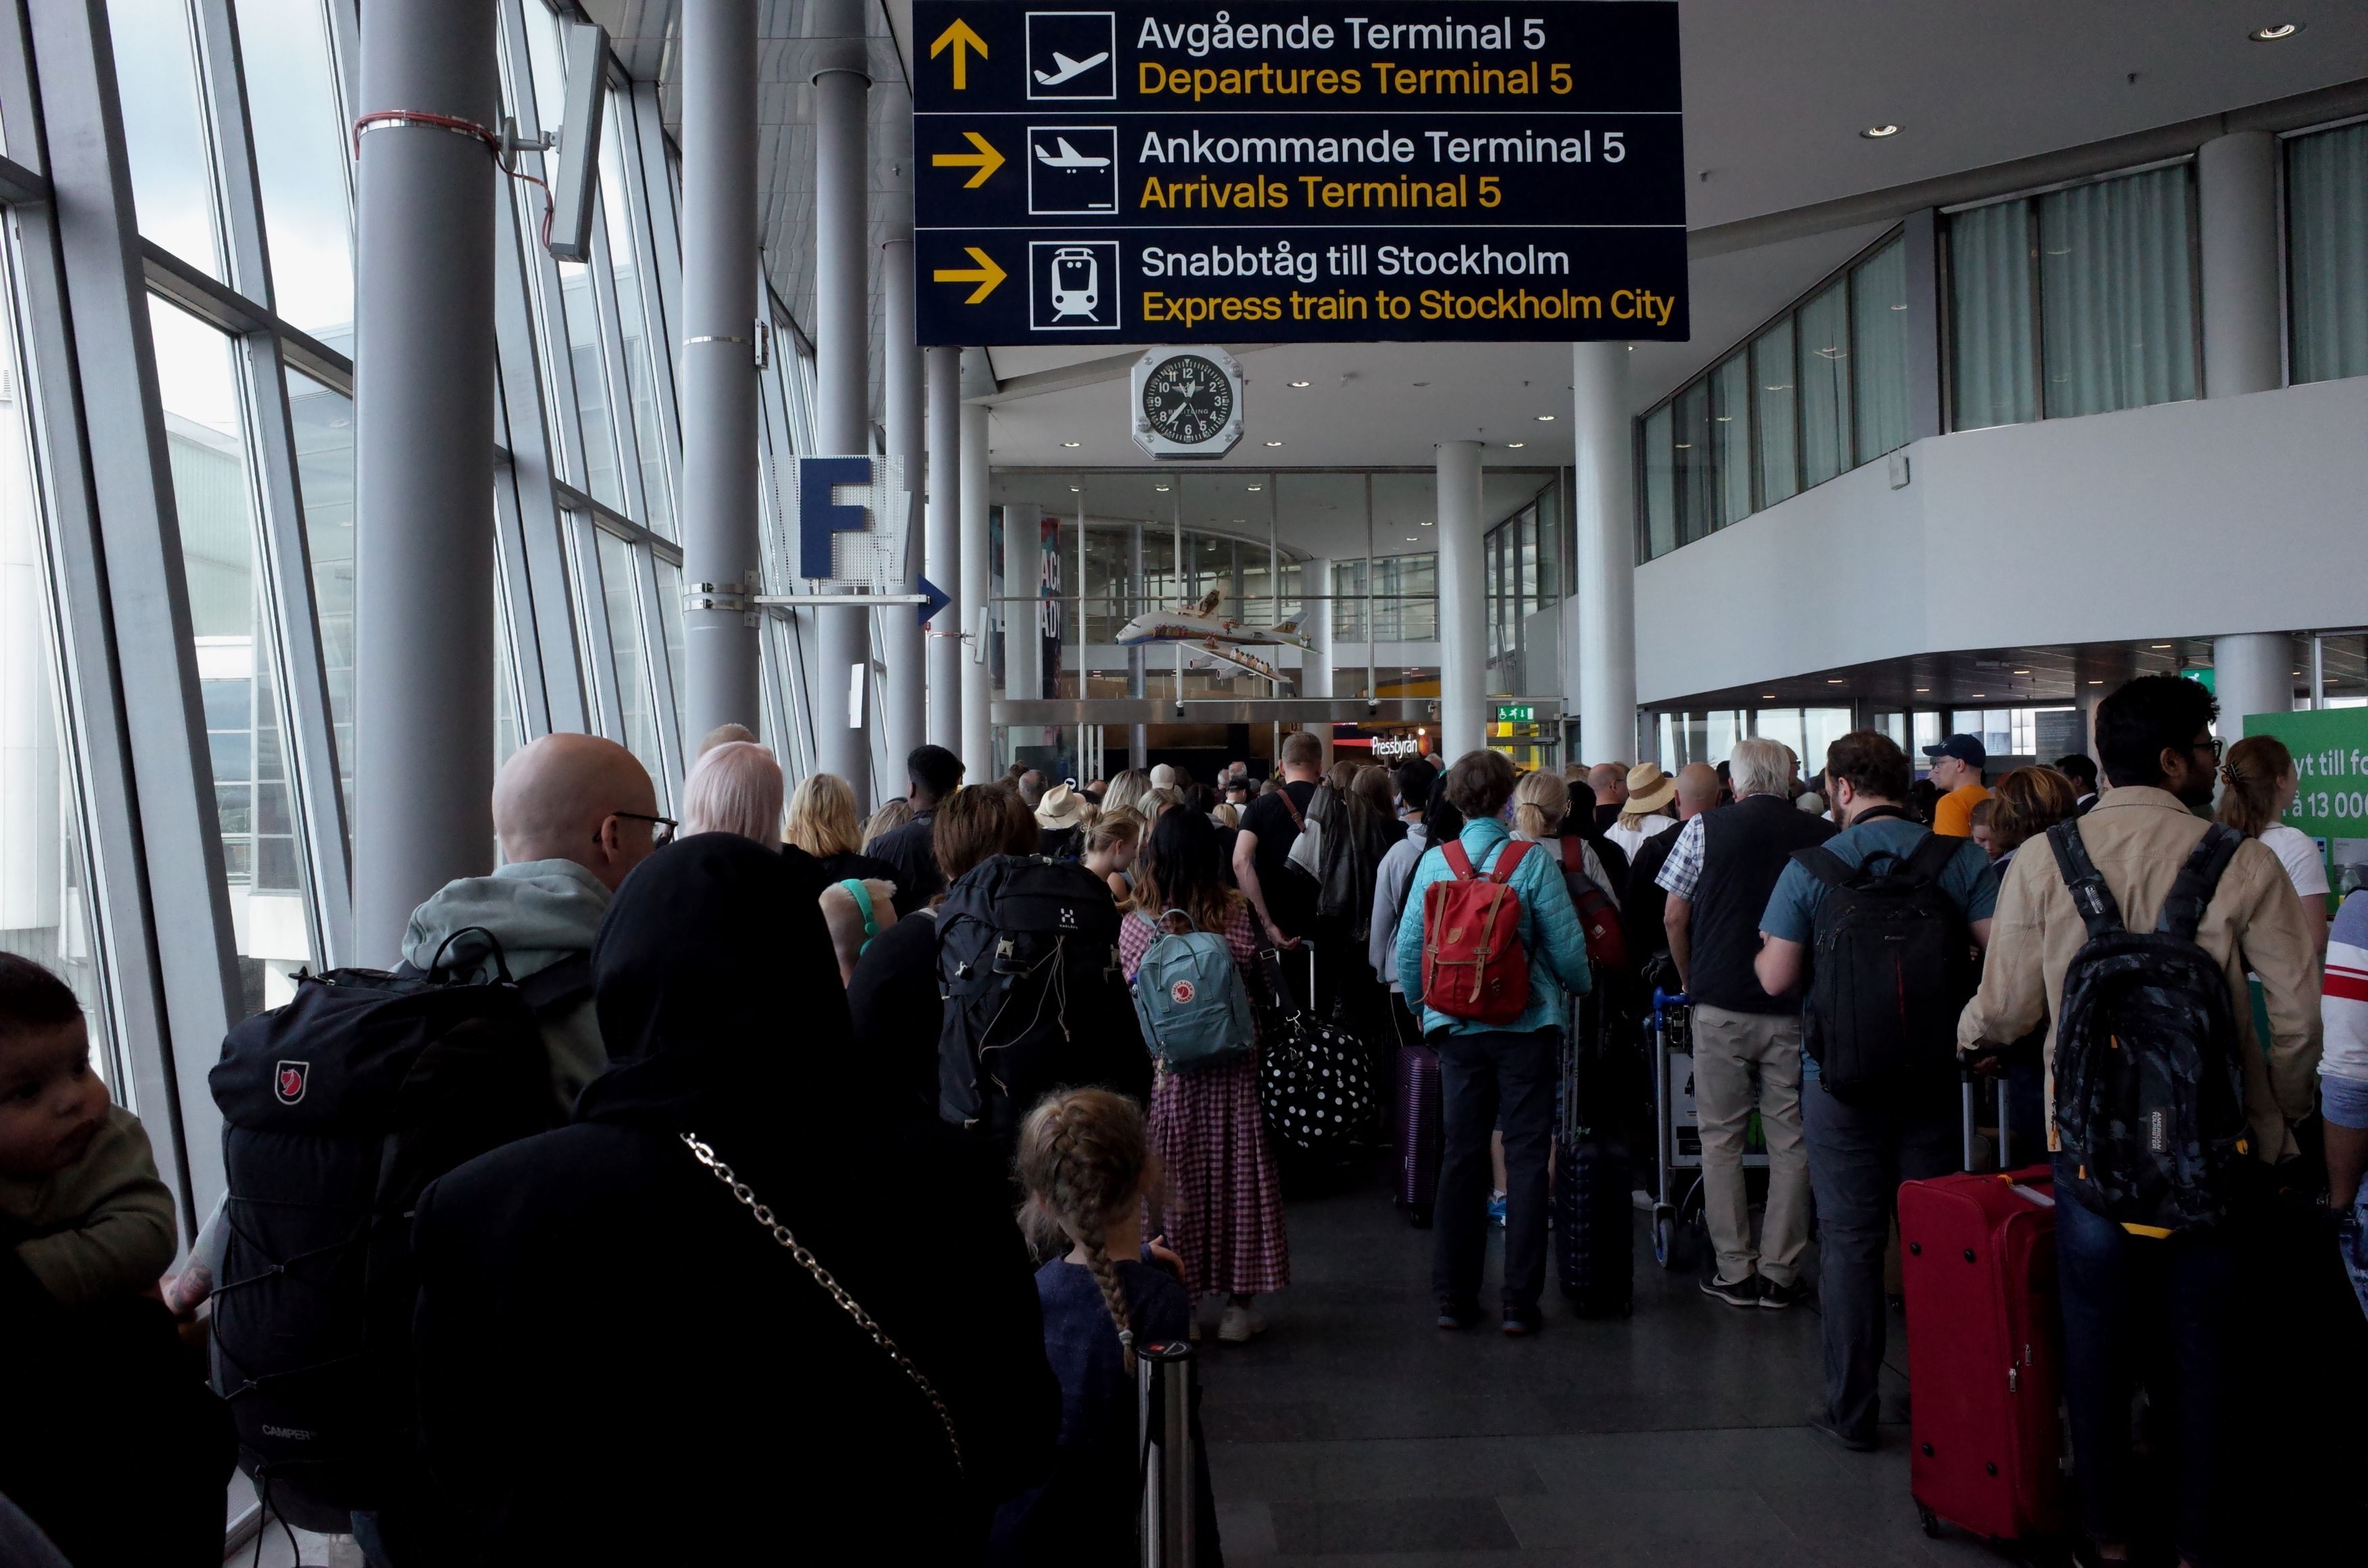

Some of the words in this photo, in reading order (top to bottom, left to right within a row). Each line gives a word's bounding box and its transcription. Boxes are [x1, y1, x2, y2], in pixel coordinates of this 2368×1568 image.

[1137, 11, 1334, 57] Avgående
[1344, 17, 1511, 49] Terminal
[1523, 18, 1545, 50] 5
[1139, 62, 1361, 101] Departures
[1371, 62, 1538, 94] Terminal
[1551, 64, 1572, 94] 5
[1139, 129, 1415, 163] Ankommande
[1424, 129, 1591, 163] Terminal
[1603, 132, 1626, 163] 5
[1140, 175, 1288, 208] Arrivals
[1298, 174, 1467, 208] Terminal
[1479, 176, 1501, 208] 5
[1142, 240, 1317, 283] Snabbtåg
[1326, 244, 1367, 275] till
[1377, 244, 1569, 275] Stockholm
[1143, 292, 1282, 328] Express
[1289, 289, 1367, 320] train
[1375, 290, 1411, 319] to
[1419, 288, 1601, 319] Stockholm
[1611, 288, 1675, 326] City
[1169, 371, 1177, 382] 11
[1183, 367, 1193, 378] 12
[1201, 371, 1204, 382] 1
[1159, 382, 1170, 393] 10
[1209, 382, 1217, 392] 2
[1154, 396, 1162, 407] 9
[1214, 396, 1222, 407] 3
[1159, 411, 1167, 422] 8
[1209, 411, 1217, 421] 4
[1172, 421, 1179, 432] 7
[1185, 424, 1192, 435] 6
[1200, 420, 1207, 432] 5
[800, 458, 873, 580] F
[1372, 734, 1417, 759] Pressbyrån
[2292, 752, 2314, 781] yt
[2319, 749, 2344, 776] till
[2307, 791, 2329, 818] 13
[2334, 791, 2368, 818] 00
[262, 1424, 311, 1440] CAMPER
